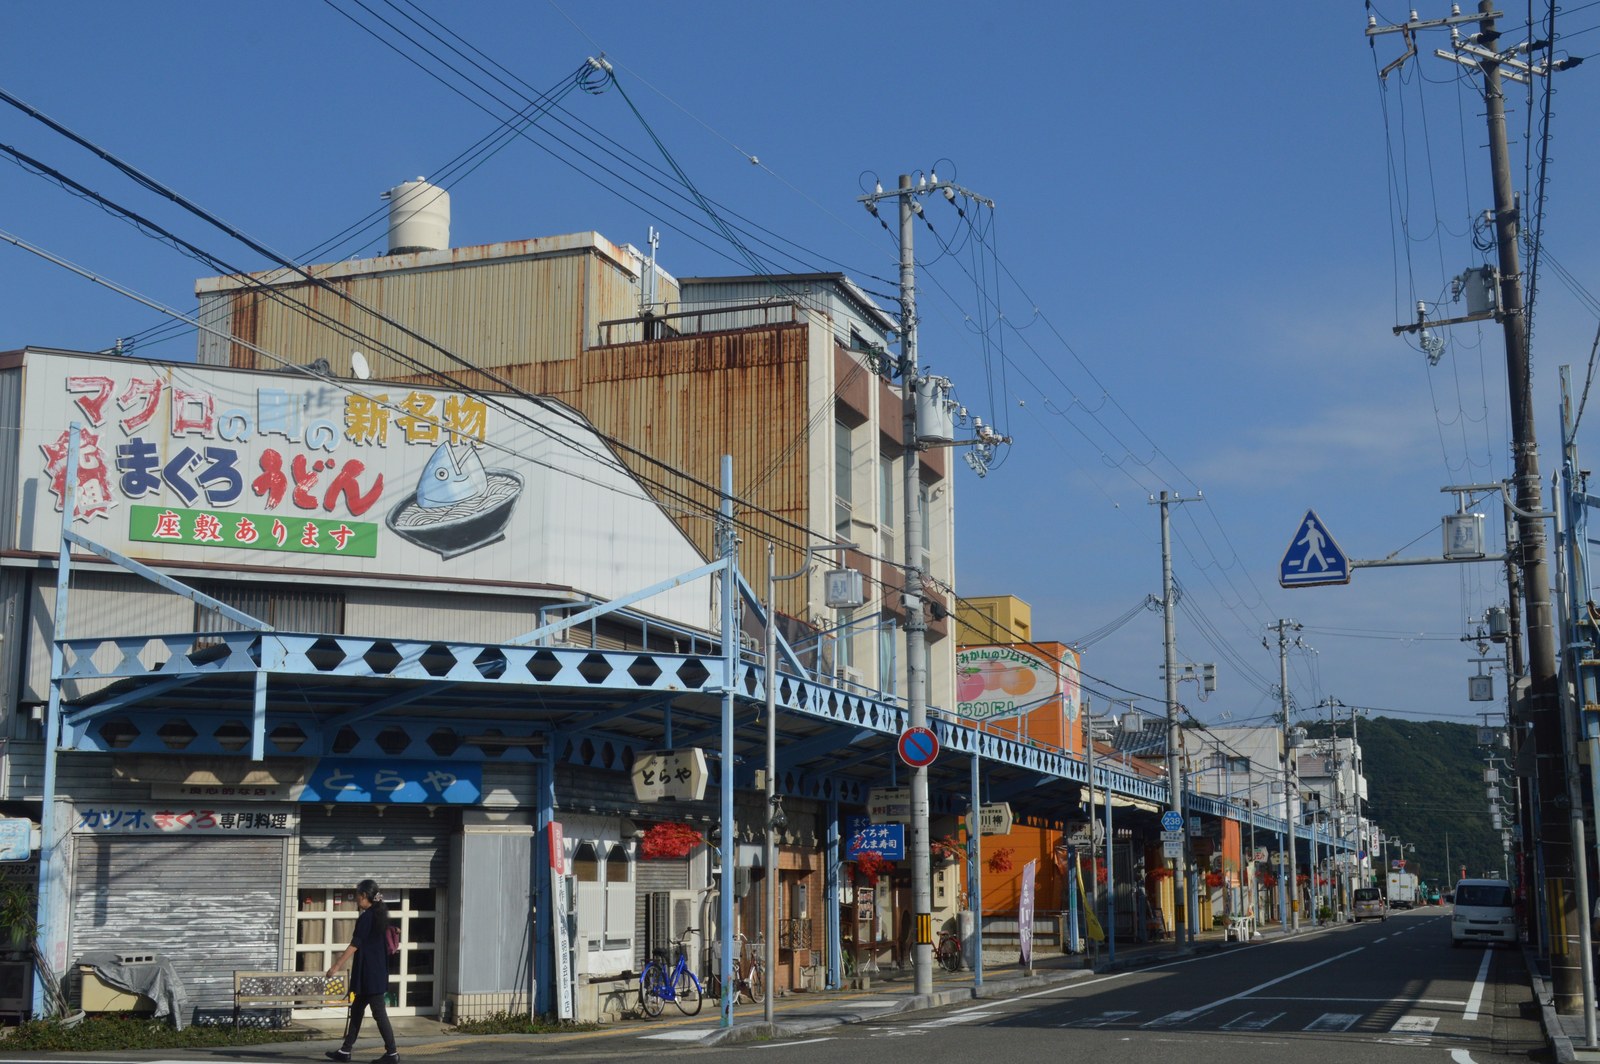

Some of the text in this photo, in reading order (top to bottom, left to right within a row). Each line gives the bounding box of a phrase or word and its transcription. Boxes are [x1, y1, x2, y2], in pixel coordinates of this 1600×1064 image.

[152, 510, 355, 549] 座敷あります
[957, 701, 1020, 718] なかにし
[323, 768, 457, 792] とらや
[642, 767, 692, 786] とらや
[970, 815, 1003, 827] 川柳
[1164, 817, 1181, 826] 238
